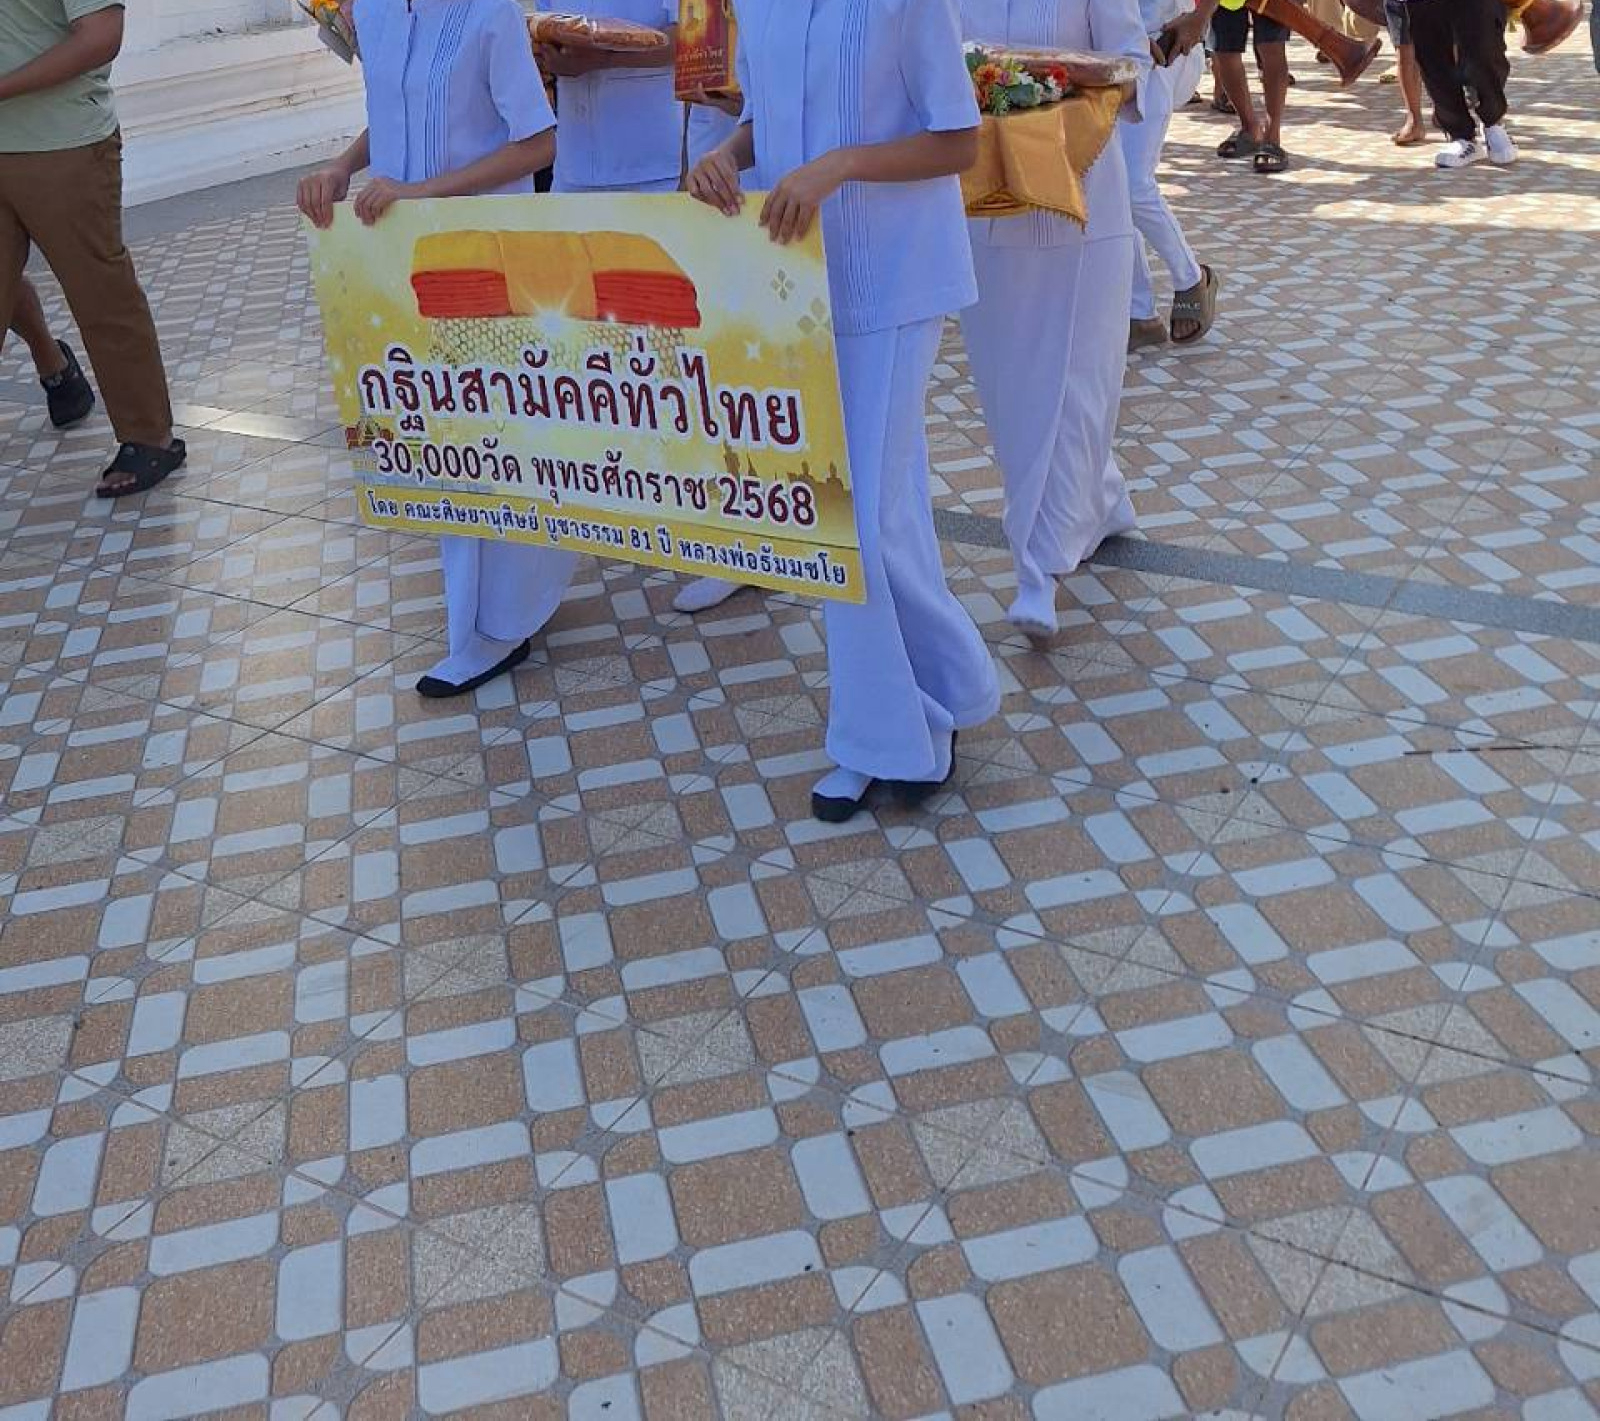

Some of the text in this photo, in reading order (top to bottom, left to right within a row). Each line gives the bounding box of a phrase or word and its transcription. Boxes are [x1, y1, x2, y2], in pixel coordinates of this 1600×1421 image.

[361, 336, 800, 445] กฐินสามัคคีทั่วไทย
[374, 436, 816, 526] 30,000วัด พุทธศักราช 2568
[367, 490, 846, 585] โดย คณะศิษยานุศิษย์ บูชาธรรม 81 ปี หลวงพ่อธัมมชโย
